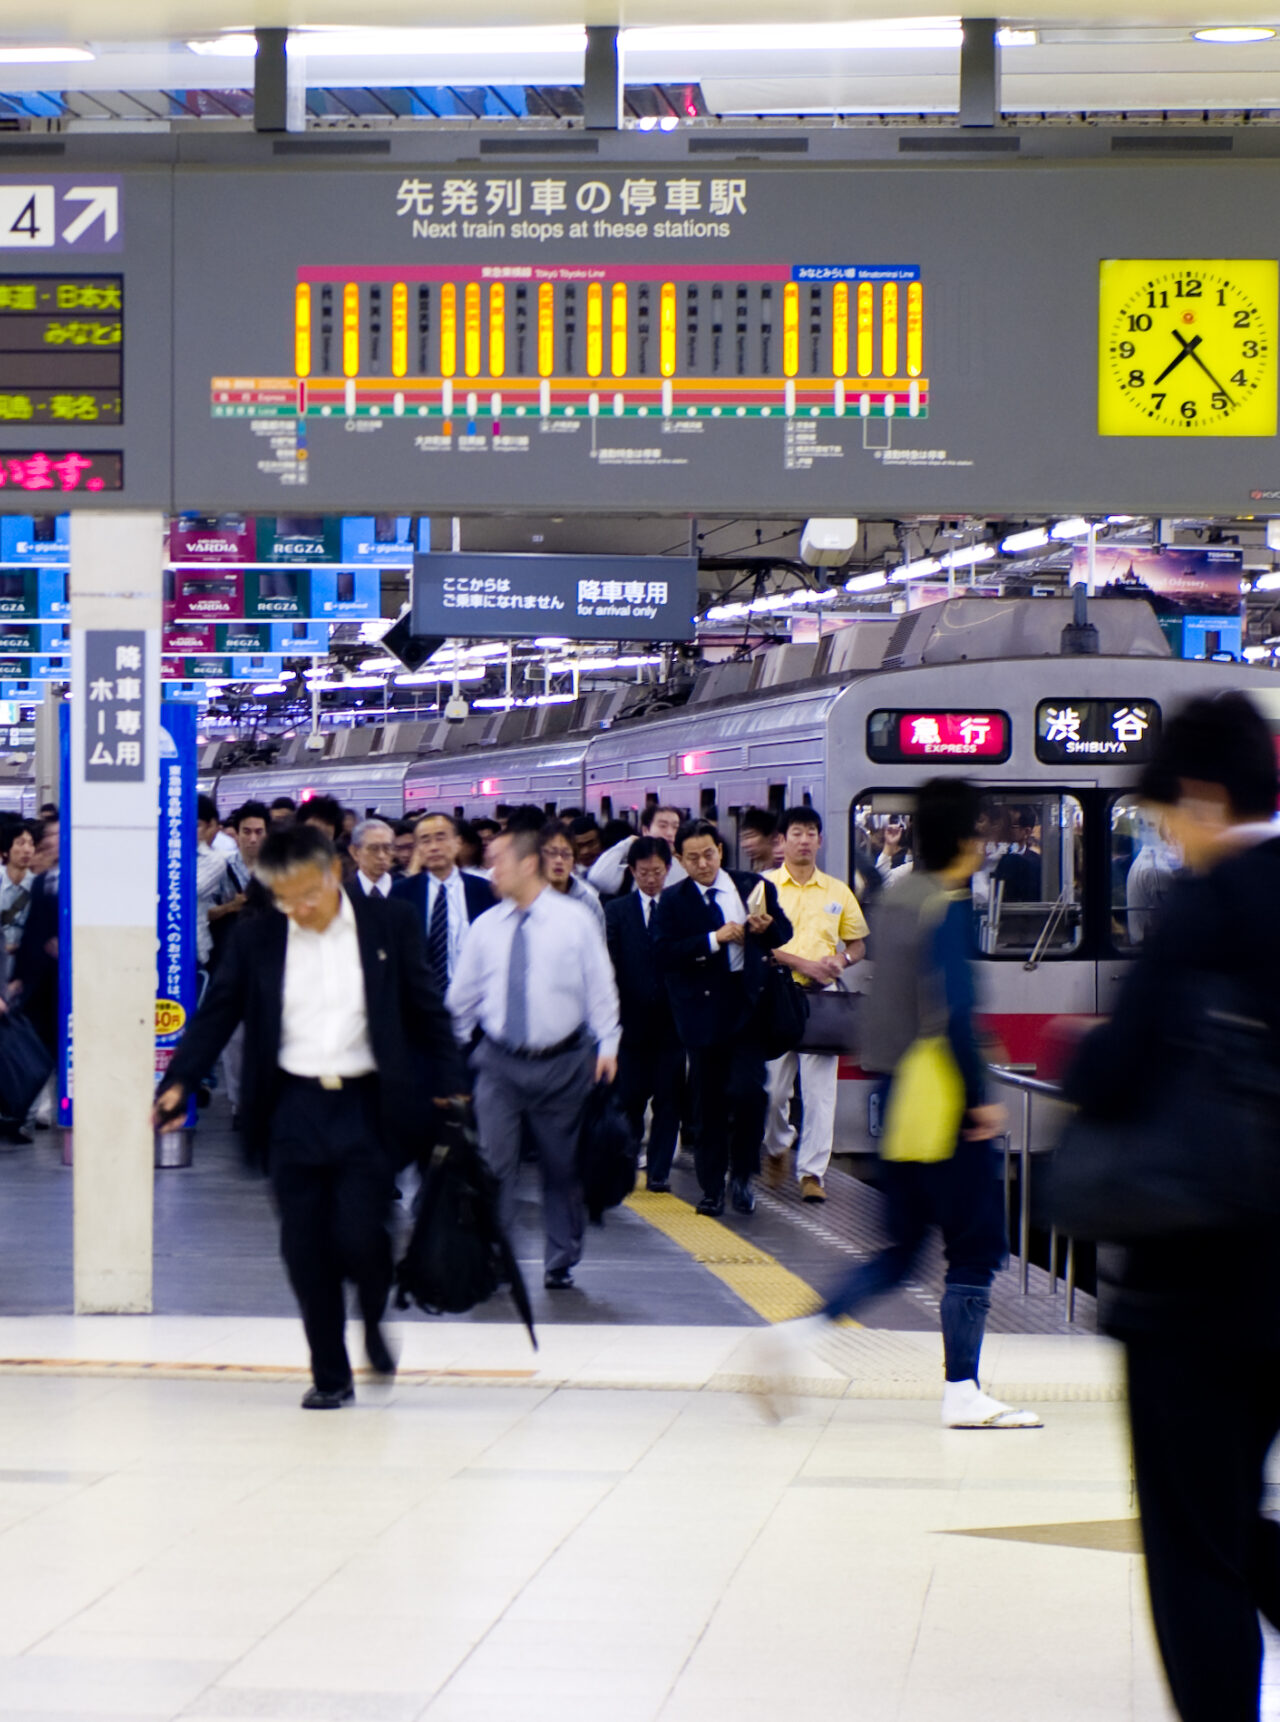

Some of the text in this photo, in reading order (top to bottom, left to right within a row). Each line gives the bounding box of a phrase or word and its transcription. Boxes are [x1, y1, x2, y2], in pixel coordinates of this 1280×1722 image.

[396, 178, 747, 216] 先発列車の停車駅
[10, 194, 40, 238] 4
[412, 219, 730, 242] Next train stops at these stations
[1175, 280, 1202, 297] 12
[1217, 289, 1226, 306] 1
[1147, 291, 1169, 308] 11
[1128, 314, 1153, 332] 10
[1233, 310, 1251, 328] 2
[1119, 341, 1135, 359] 9
[1242, 341, 1259, 358] 3
[1128, 370, 1145, 388] 8
[1230, 369, 1247, 387] 4
[1151, 393, 1167, 410] 7
[1211, 391, 1228, 409] 5
[1180, 401, 1197, 419] 6
[274, 543, 324, 553] REGZA
[442, 577, 511, 592] ここからは
[577, 579, 668, 604] 降車専用
[257, 602, 298, 612] REGZA
[577, 604, 657, 619] for arrival only
[116, 645, 141, 766] 降車専用
[910, 717, 991, 745] 急行
[1045, 707, 1148, 742] 渋谷
[924, 743, 977, 754] EXPRESS
[1065, 742, 1128, 754] SHIBUYA
